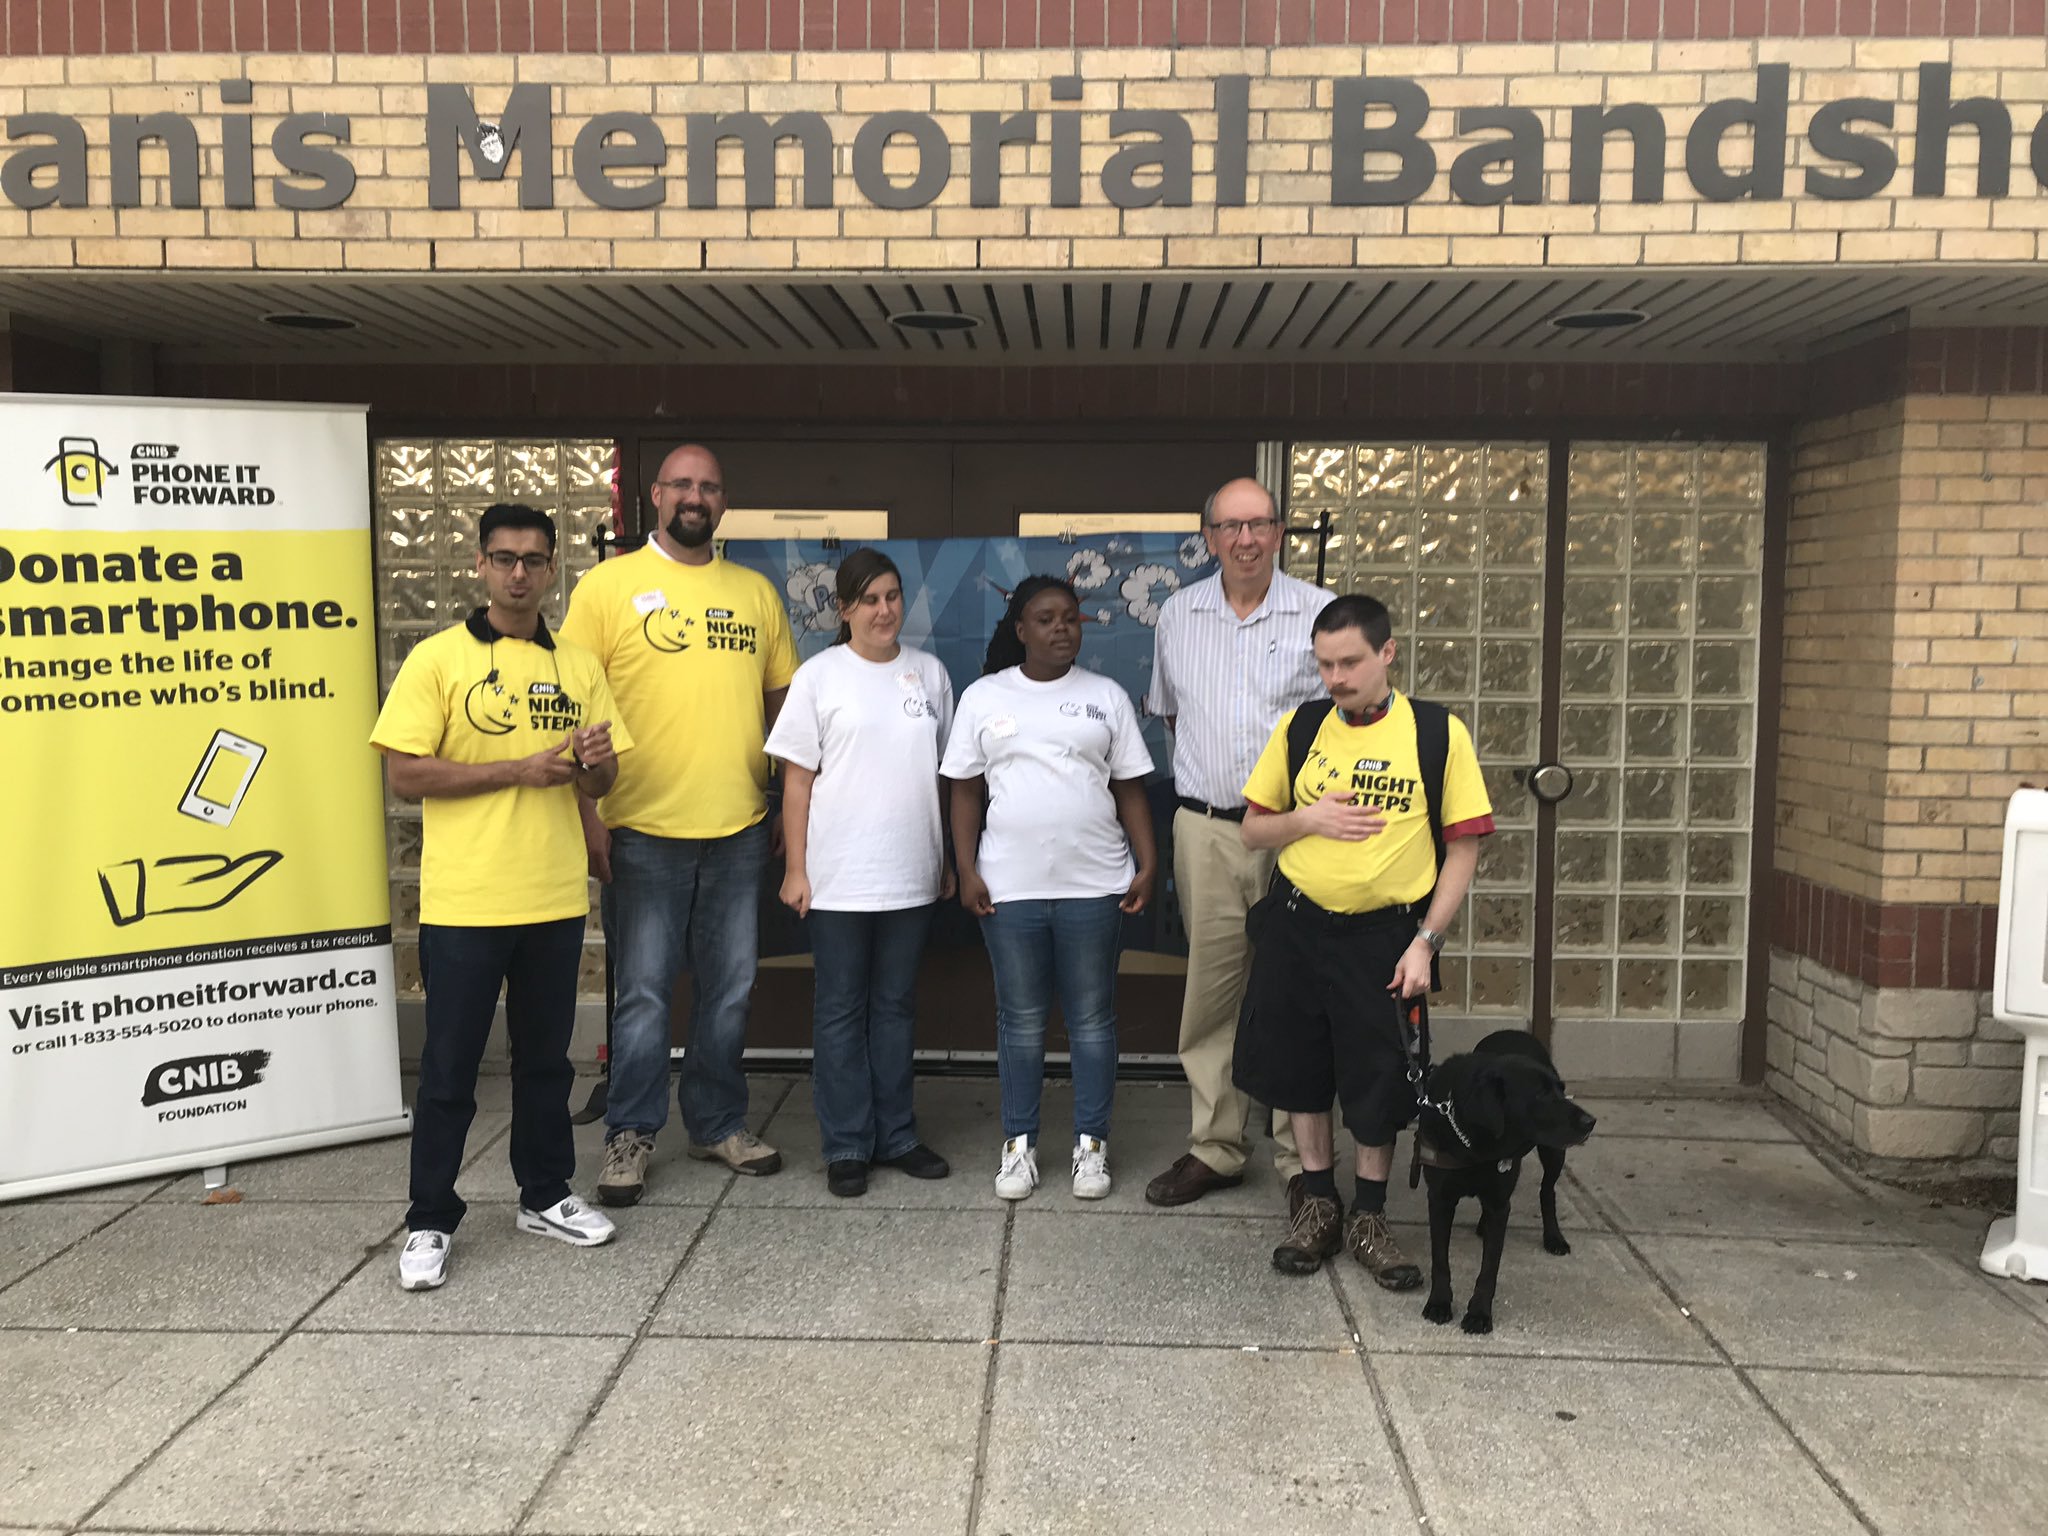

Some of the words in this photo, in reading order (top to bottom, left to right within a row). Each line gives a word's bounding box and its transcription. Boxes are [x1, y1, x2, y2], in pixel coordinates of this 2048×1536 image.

[427, 74, 1249, 211] Memorial
[1331, 61, 2048, 206] Bandsh
[136, 445, 169, 458] CNIB
[131, 463, 231, 484] PHONE
[235, 464, 260, 484] IT
[133, 485, 276, 506] FORWARD
[211, 552, 243, 581] a
[0, 593, 358, 641] martphone.
[706, 620, 757, 639] NIGHT
[707, 636, 757, 655] STEPS
[0, 655, 112, 681] hange
[121, 651, 175, 675] the
[183, 648, 233, 672] life
[241, 647, 272, 670] of
[150, 681, 242, 706] who's
[249, 677, 335, 702] blind.
[1351, 773, 1418, 795] NIGHT
[1347, 792, 1411, 813] STEPS
[3, 970, 44, 986] Every
[47, 963, 97, 980] eligible
[100, 954, 183, 974] smartphone
[185, 946, 243, 963] donation
[246, 941, 298, 956] receives
[300, 939, 308, 950] a
[311, 937, 330, 949] tax
[333, 932, 378, 947] receipt.
[9, 1000, 85, 1031] Visit
[92, 968, 377, 1025] phoneitforward.ca
[12, 1042, 32, 1055] or
[36, 1035, 66, 1051] call
[70, 1017, 203, 1047] 1-833-554-5020
[206, 1014, 224, 1027] to
[227, 1007, 283, 1025] donate
[286, 1002, 323, 1020] your
[326, 996, 378, 1015] phone.
[158, 1059, 243, 1095] CNIB
[158, 1099, 247, 1123] FOUNDATION
